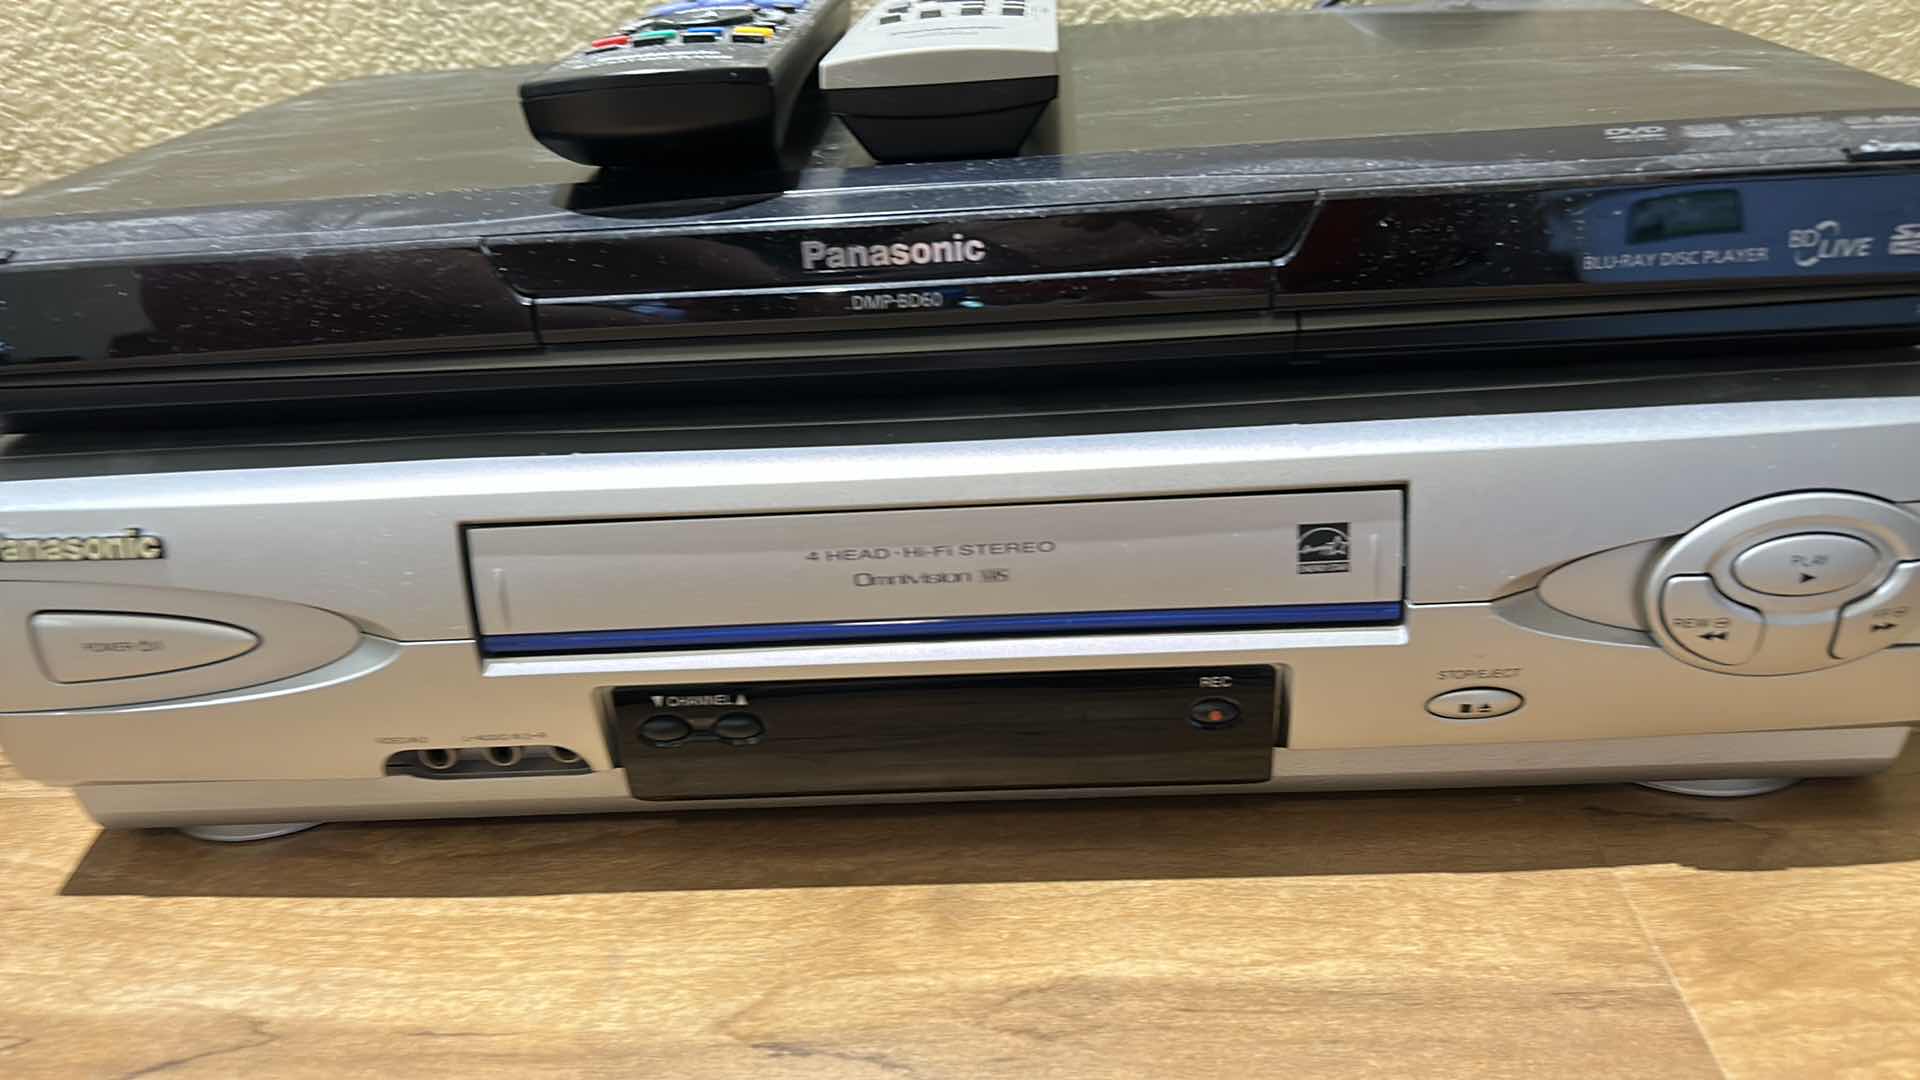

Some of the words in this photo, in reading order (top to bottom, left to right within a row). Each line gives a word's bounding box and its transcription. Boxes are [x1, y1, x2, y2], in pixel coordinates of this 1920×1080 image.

[801, 233, 986, 270] Panasonic
[1819, 238, 1873, 258] LIVE
[1583, 254, 1655, 270] BLU-RAY
[1659, 252, 1699, 266] DISC
[0, 527, 164, 562] anasonic
[825, 548, 890, 561] HEAD
[959, 541, 1056, 556] STEREO
[1200, 676, 1233, 688] REC
